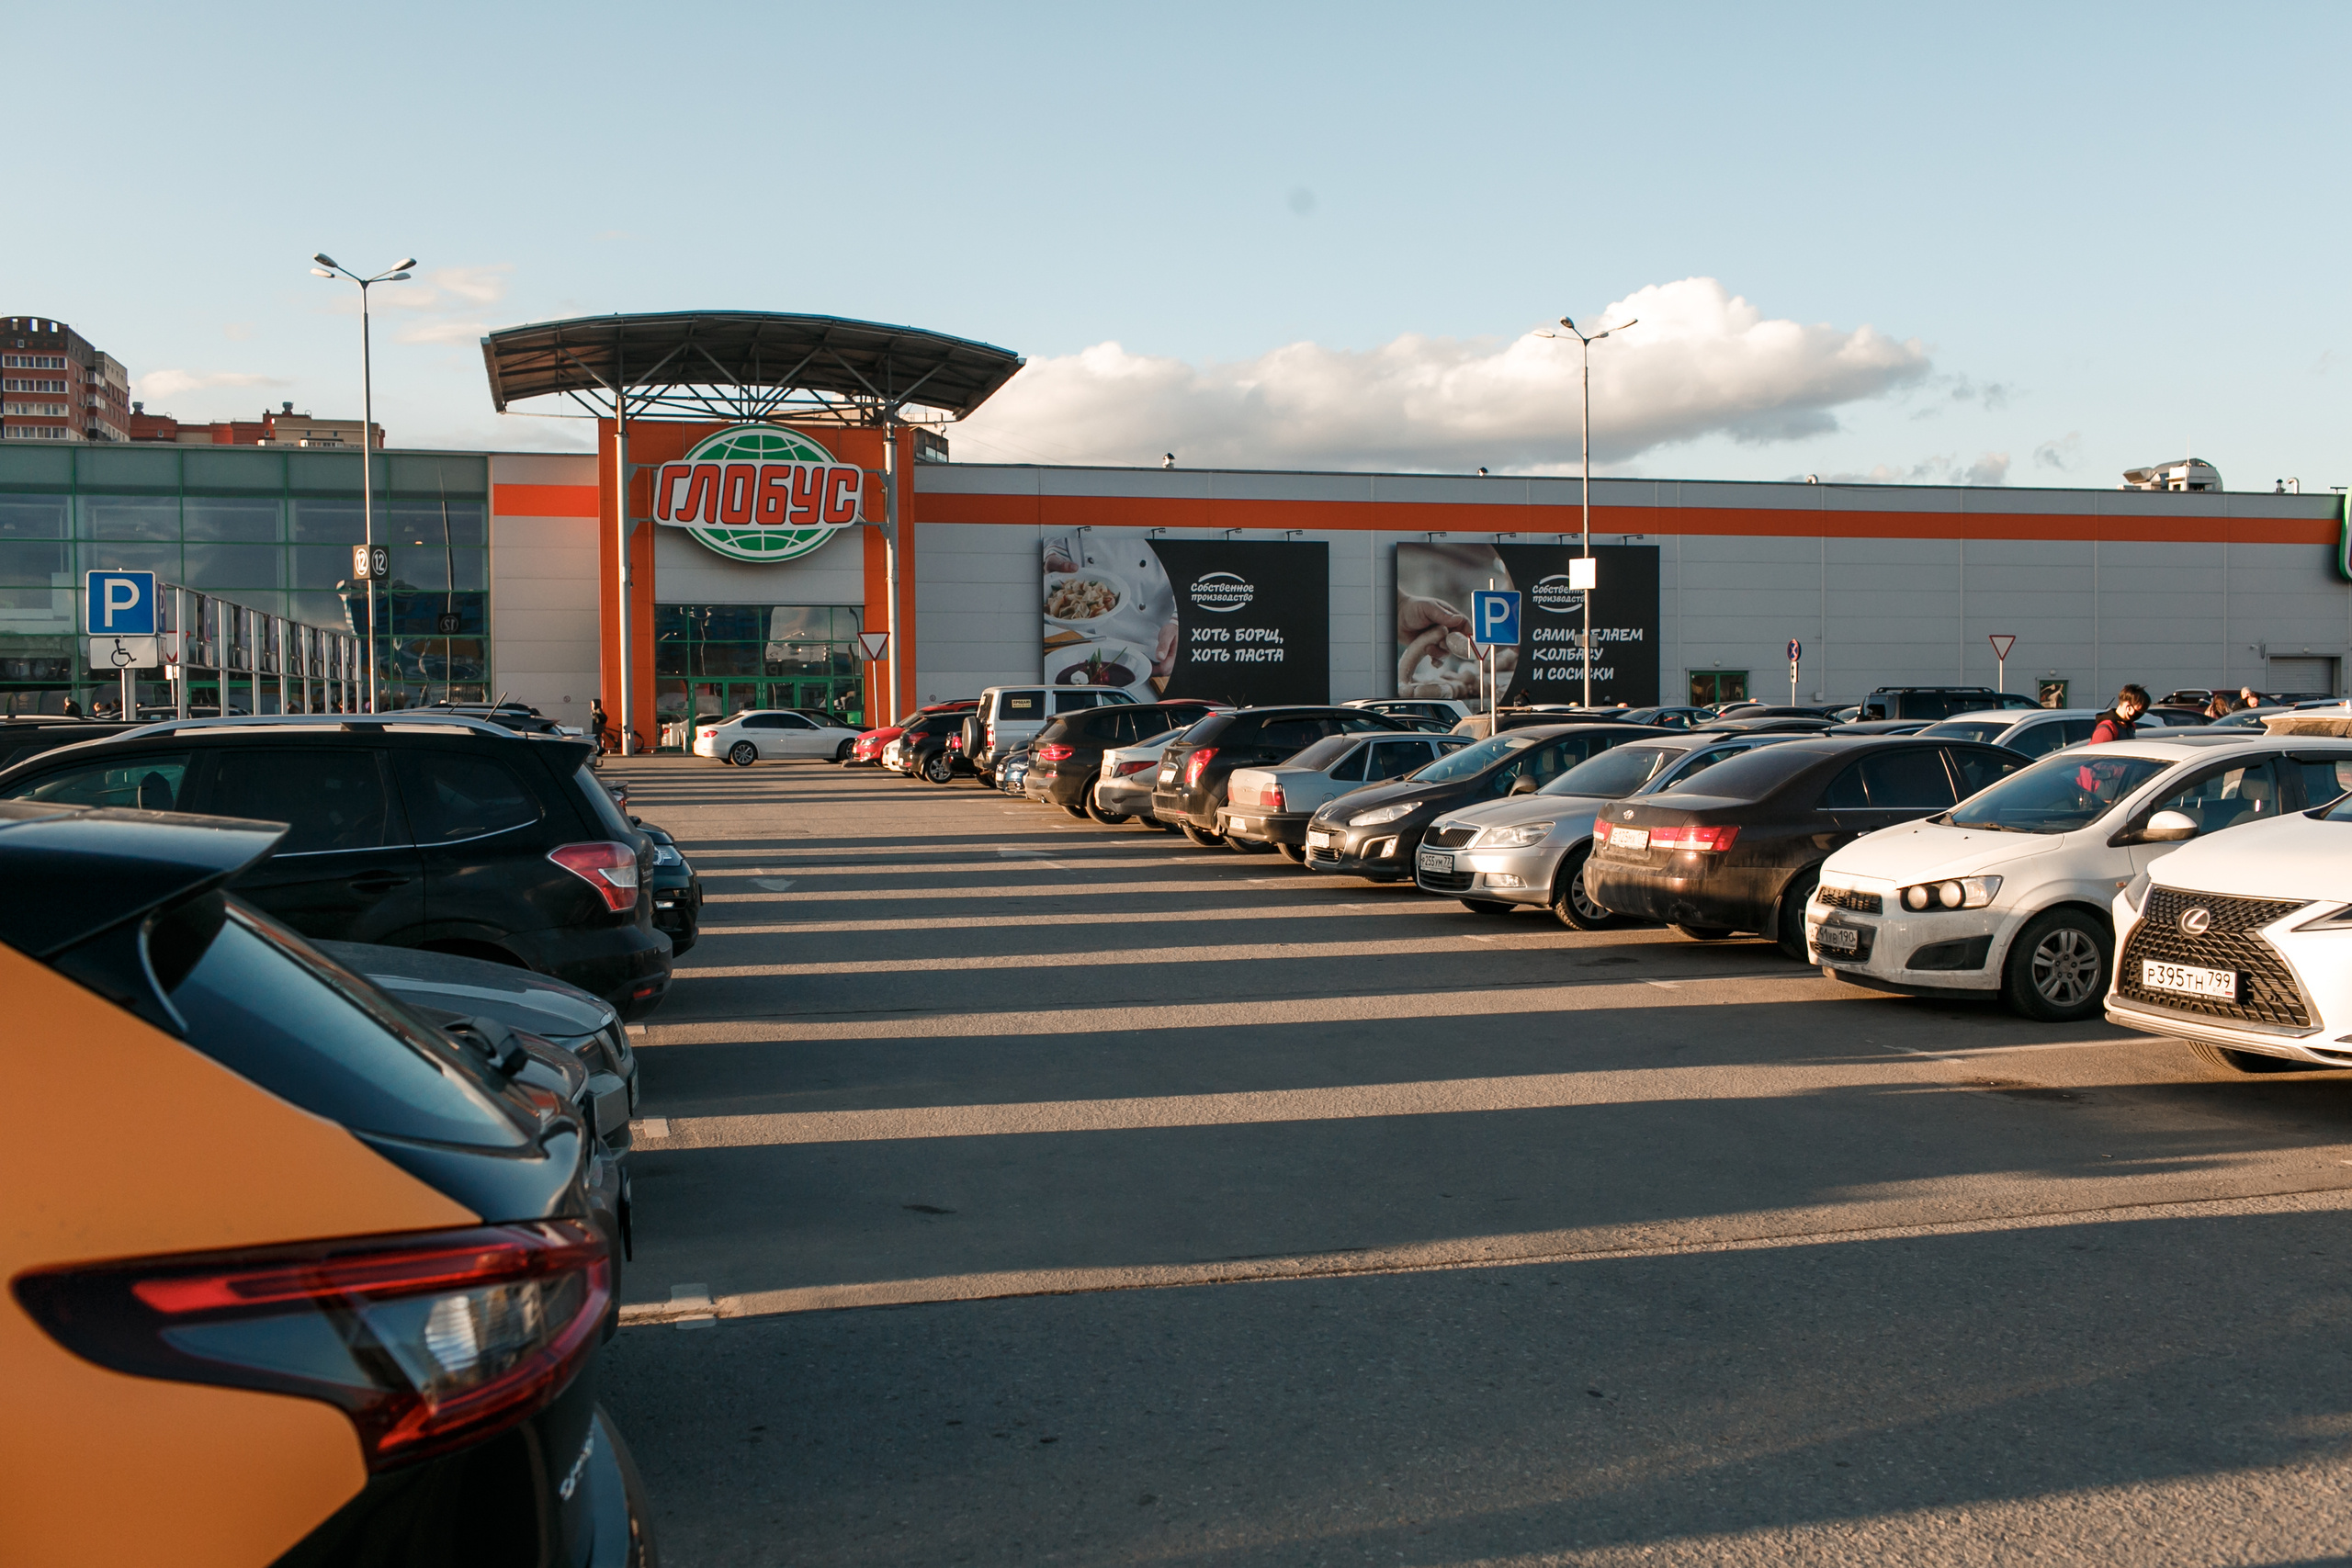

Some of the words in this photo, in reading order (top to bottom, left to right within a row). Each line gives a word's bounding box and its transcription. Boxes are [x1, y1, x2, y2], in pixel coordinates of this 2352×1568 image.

[657, 463, 860, 525] ГЛОБУС
[356, 553, 367, 571] 12
[374, 553, 385, 571] 12
[1191, 582, 1254, 592] Собственное
[104, 578, 141, 627] P
[1191, 593, 1253, 603] производство
[1532, 595, 1585, 604] производств
[1485, 597, 1510, 637] P
[1191, 628, 1230, 642] ХОТЬ
[1235, 628, 1284, 644] БОРЩ,
[1532, 628, 1576, 641] САМИ
[1191, 649, 1231, 662] ХОТЬ
[1235, 649, 1284, 661] ПАСТА
[1533, 667, 1544, 681] И
[1839, 931, 1854, 943] 190
[2147, 964, 2204, 990] Р395ТН
[2208, 971, 2231, 988] 799
